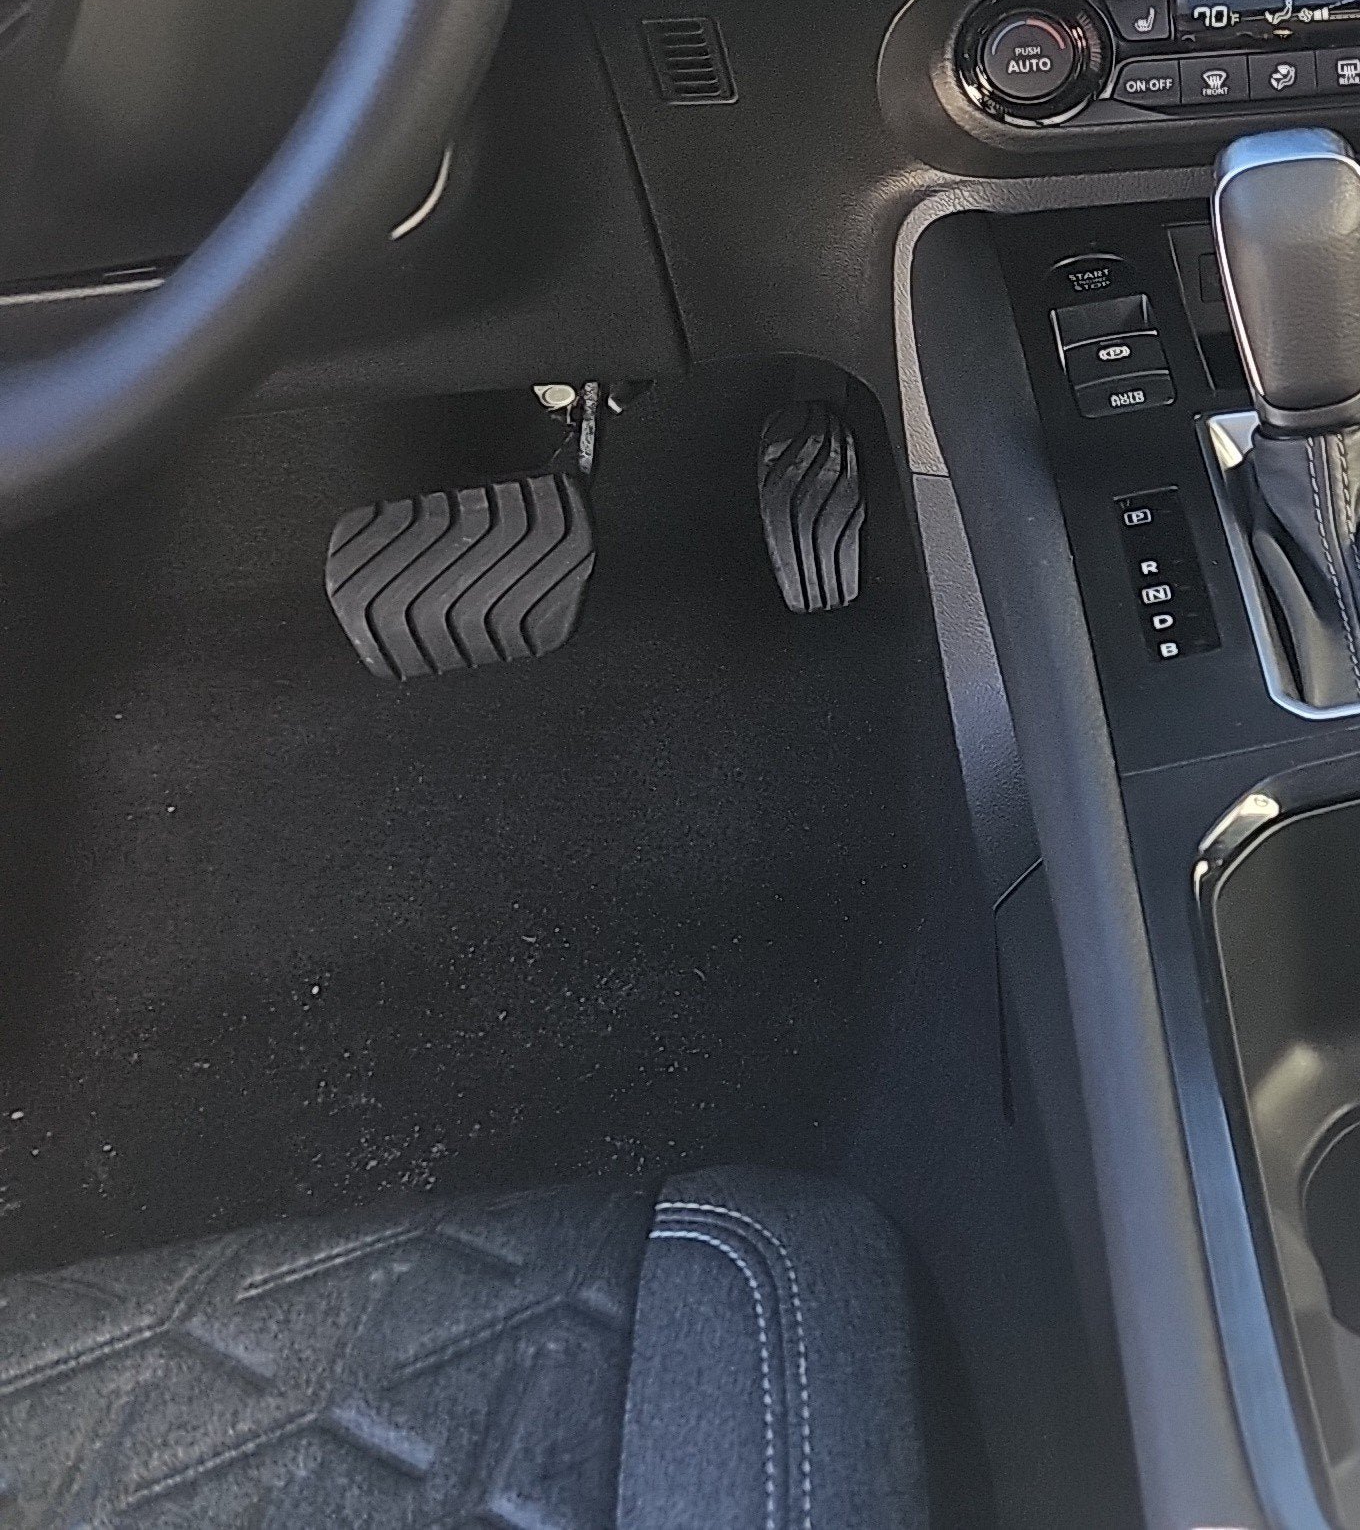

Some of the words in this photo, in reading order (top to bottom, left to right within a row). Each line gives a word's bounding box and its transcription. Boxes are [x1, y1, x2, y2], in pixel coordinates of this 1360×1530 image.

[1193, 5, 1228, 27] 70
[1015, 46, 1041, 57] PUSH
[1007, 57, 1051, 73] AUTO
[1202, 86, 1229, 96] FRONT
[1068, 268, 1109, 281] START
[1140, 560, 1159, 575] R
[1152, 614, 1174, 630] D
[1159, 642, 1179, 658] B
